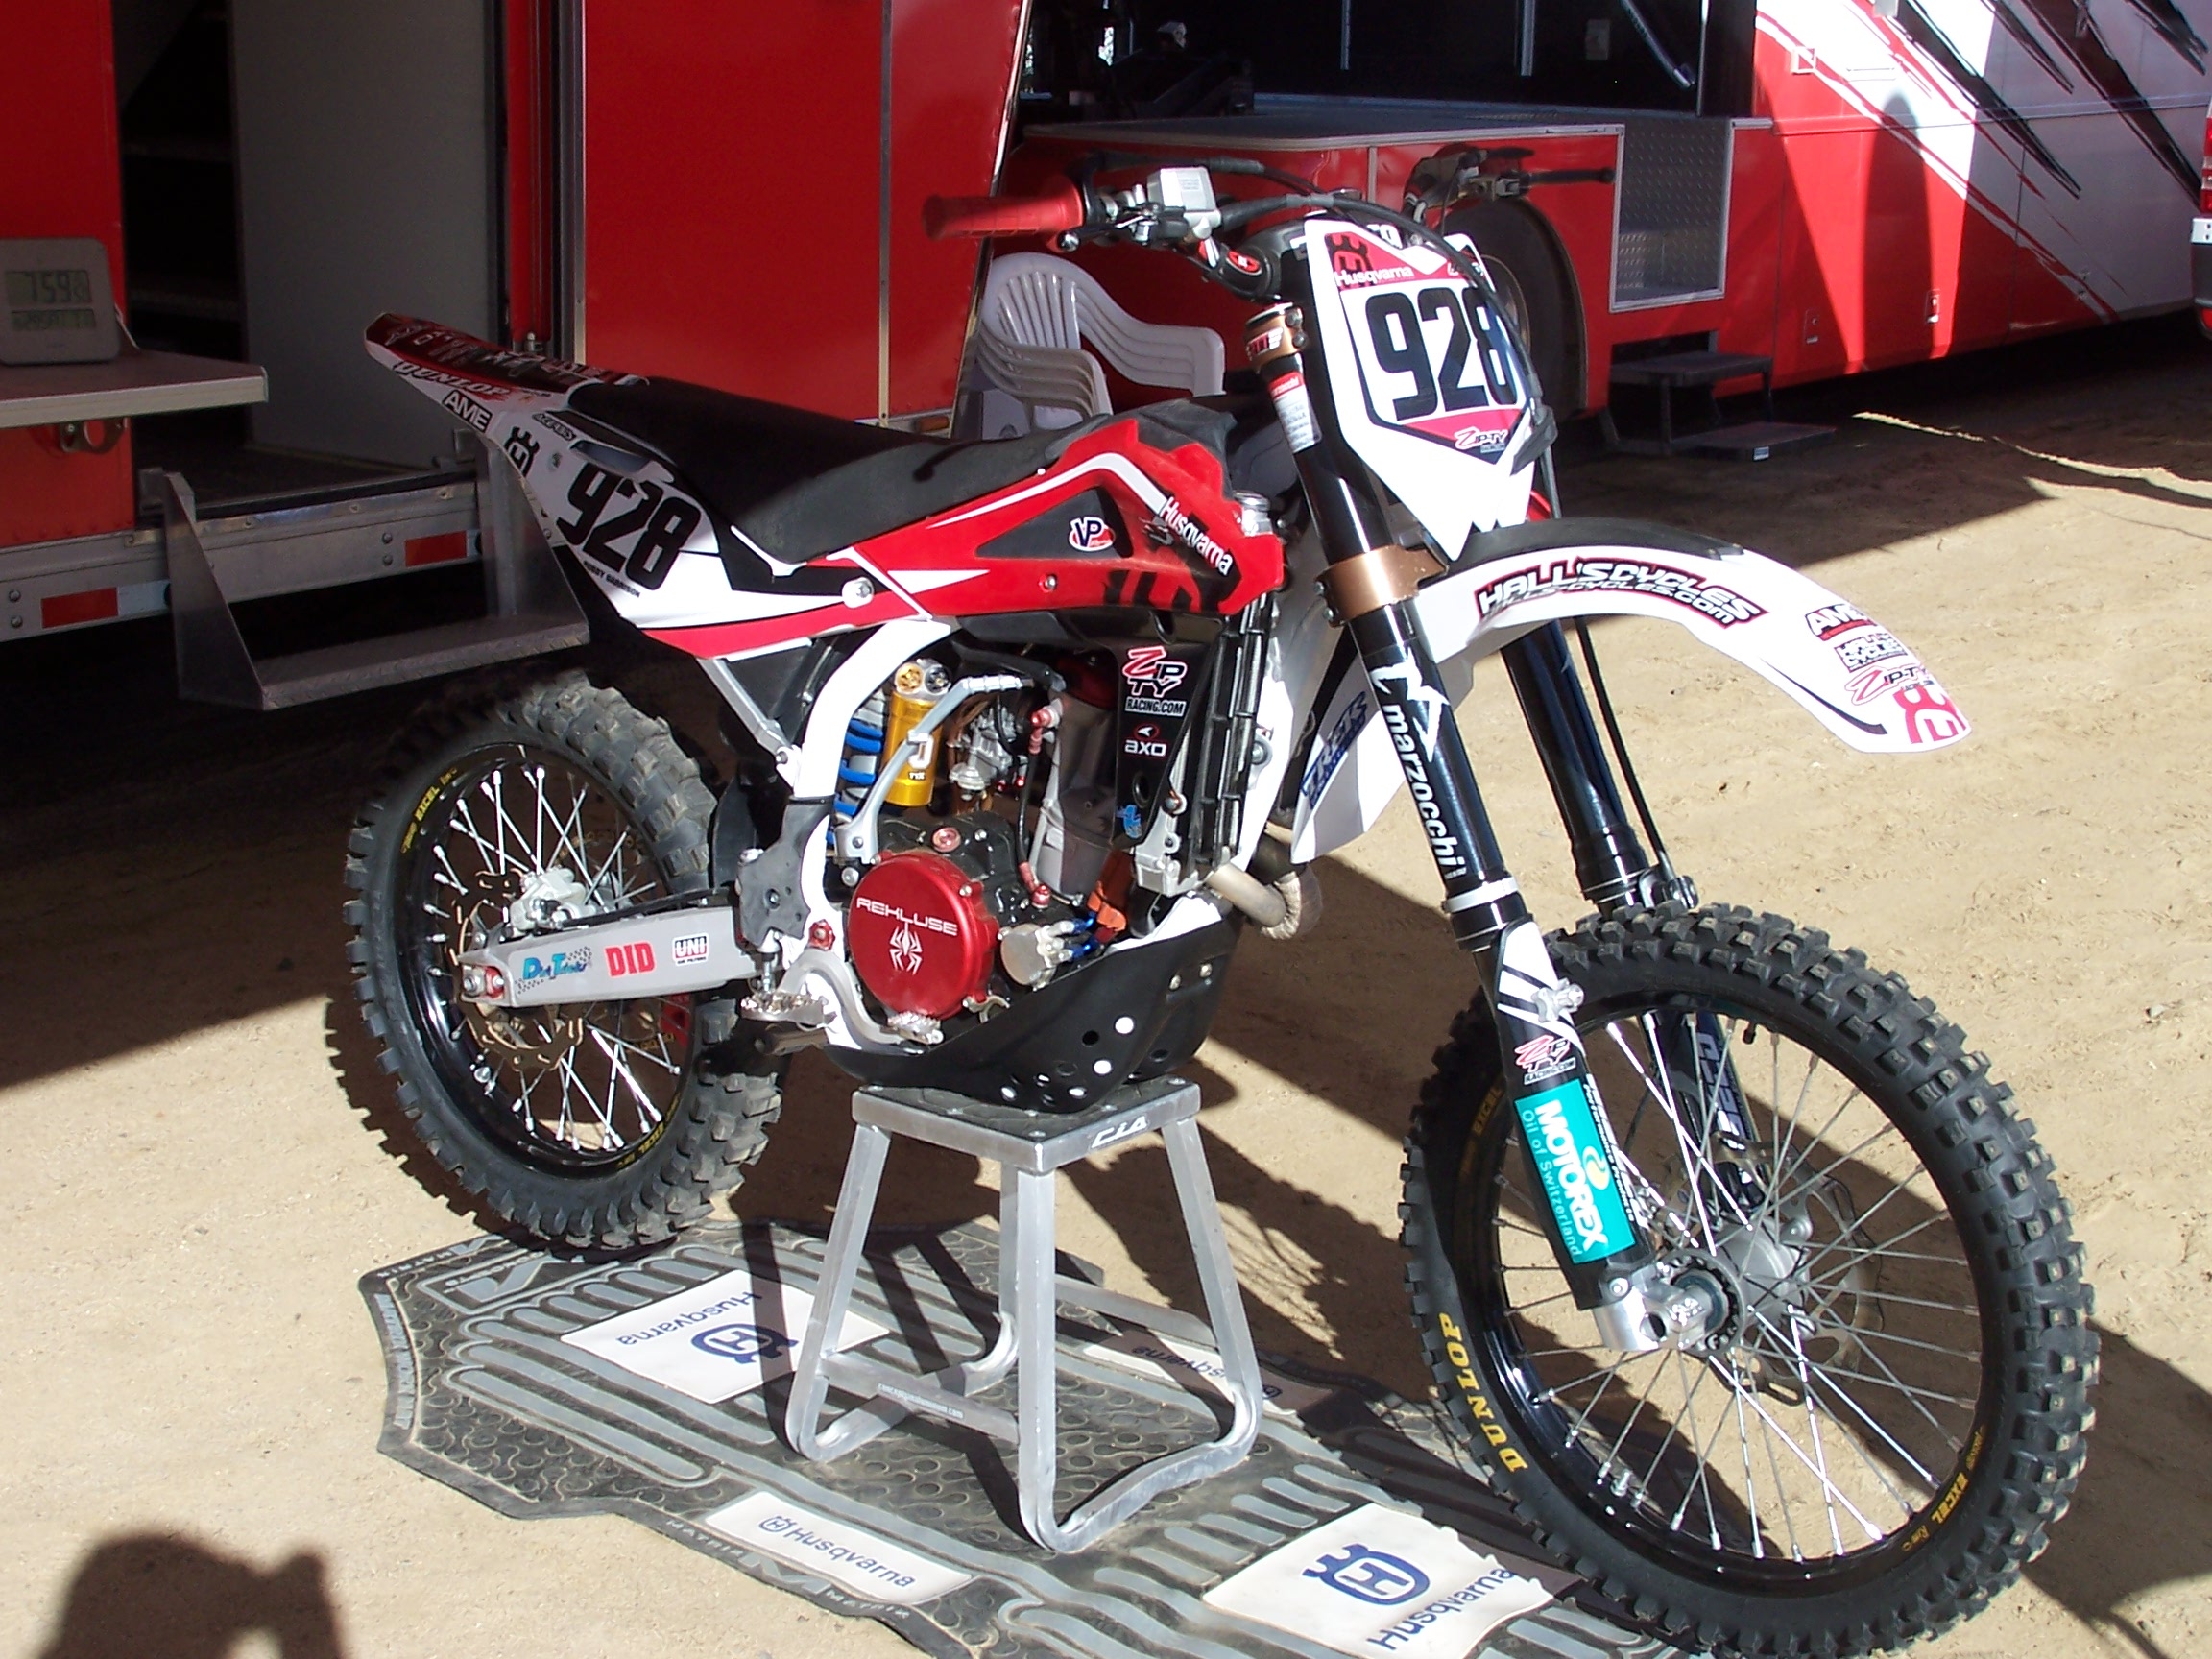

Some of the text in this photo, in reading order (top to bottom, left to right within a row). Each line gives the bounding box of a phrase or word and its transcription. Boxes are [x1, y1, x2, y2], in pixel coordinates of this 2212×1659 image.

[1334, 265, 1414, 287] Husqvarna
[395, 360, 512, 397] DUNLOP
[1365, 287, 1518, 421] 928
[445, 391, 490, 431] AME
[556, 462, 701, 590] 928
[1072, 517, 1103, 547] VP
[1160, 496, 1233, 575] Husqvarna
[1126, 698, 1186, 716] RACING.COM
[1382, 704, 1466, 867] marzocchi
[856, 896, 959, 938] REKLUSE
[605, 943, 657, 977] DID
[676, 937, 706, 958] UNI
[1522, 1109, 1582, 1256] Oil of Switzerland
[1535, 1099, 1608, 1251] MOTOREX
[616, 1289, 763, 1346] Husqvarna
[1440, 1312, 1528, 1473] DUNLOP
[787, 1525, 916, 1589] Husqvarna
[1367, 1566, 1517, 1651] Husqvarna
